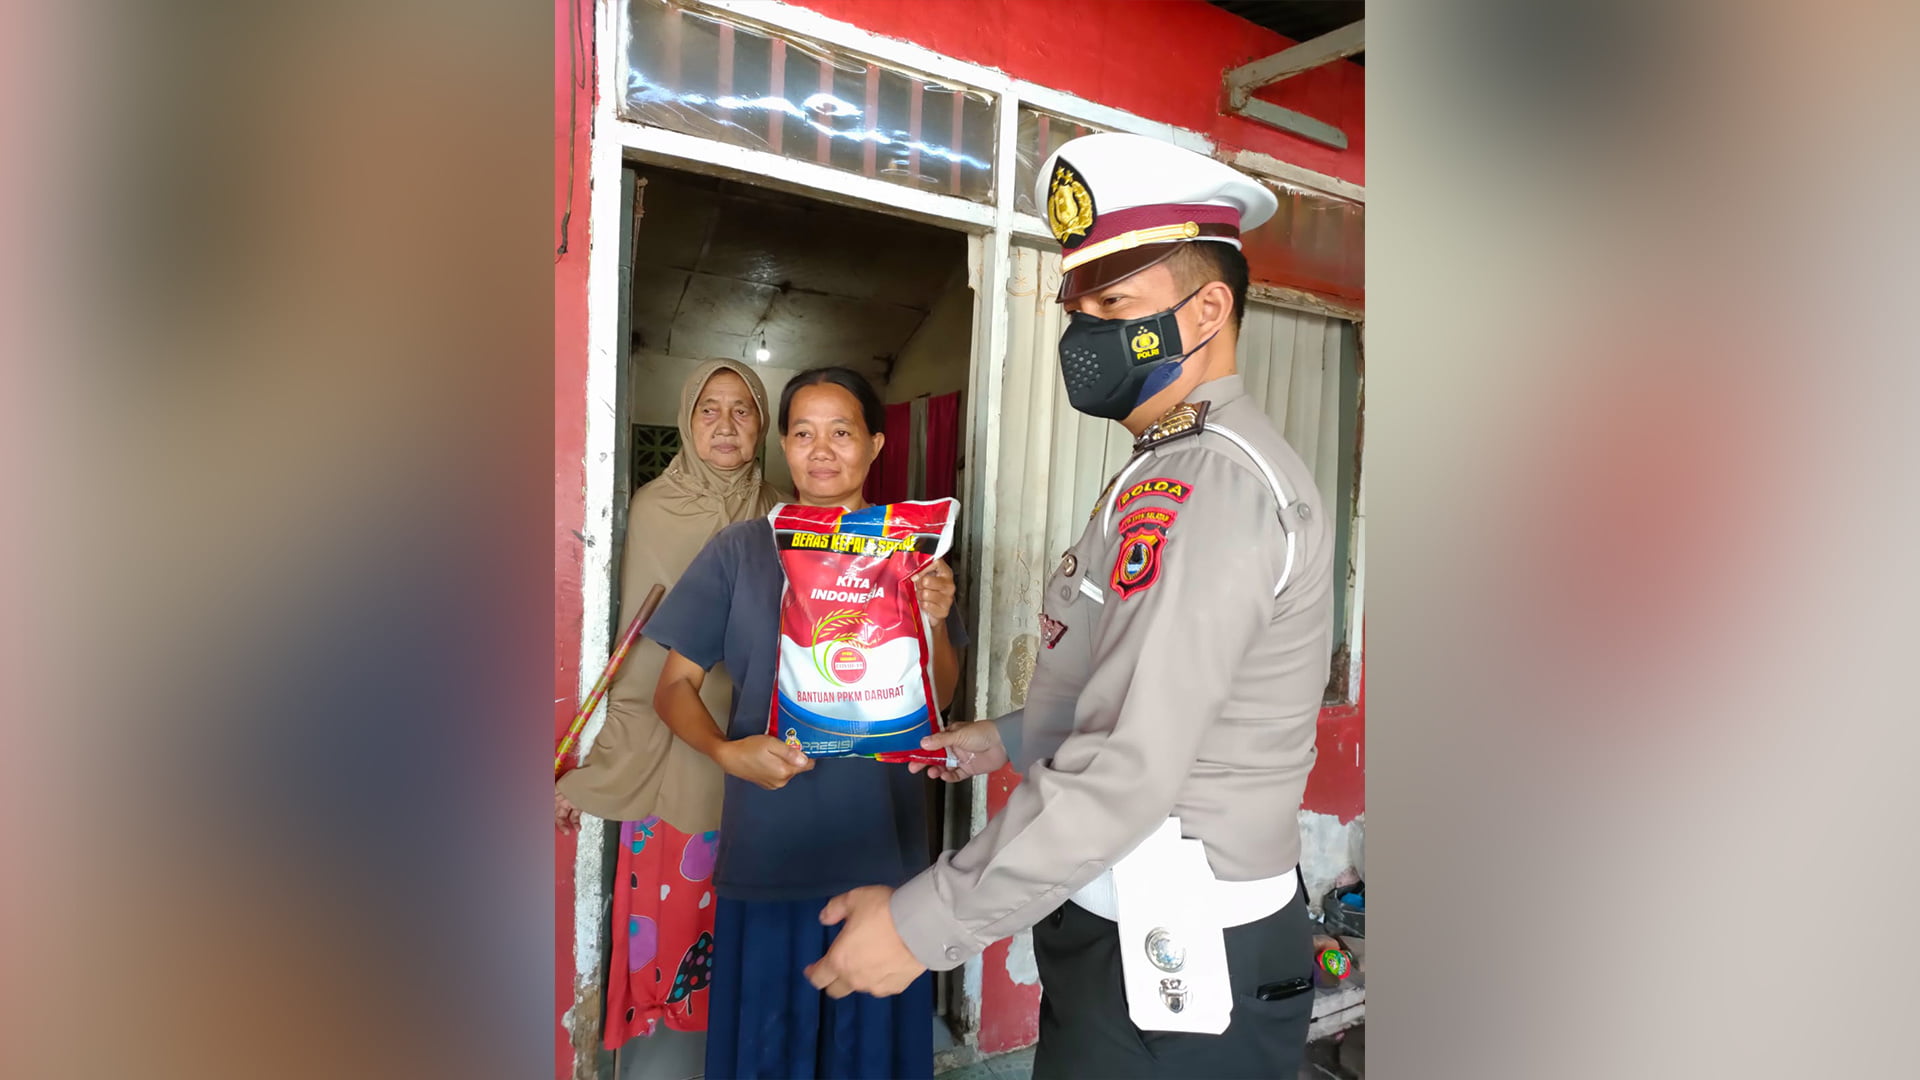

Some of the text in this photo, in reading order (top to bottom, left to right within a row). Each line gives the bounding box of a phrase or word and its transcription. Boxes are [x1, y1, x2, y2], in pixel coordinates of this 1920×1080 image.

[1121, 481, 1182, 504] POLDA
[791, 532, 830, 549] BERAS
[836, 575, 870, 589] KITA
[796, 684, 905, 703] BANTUAN PPKM DARURAT
[802, 740, 854, 752] PRESISI
